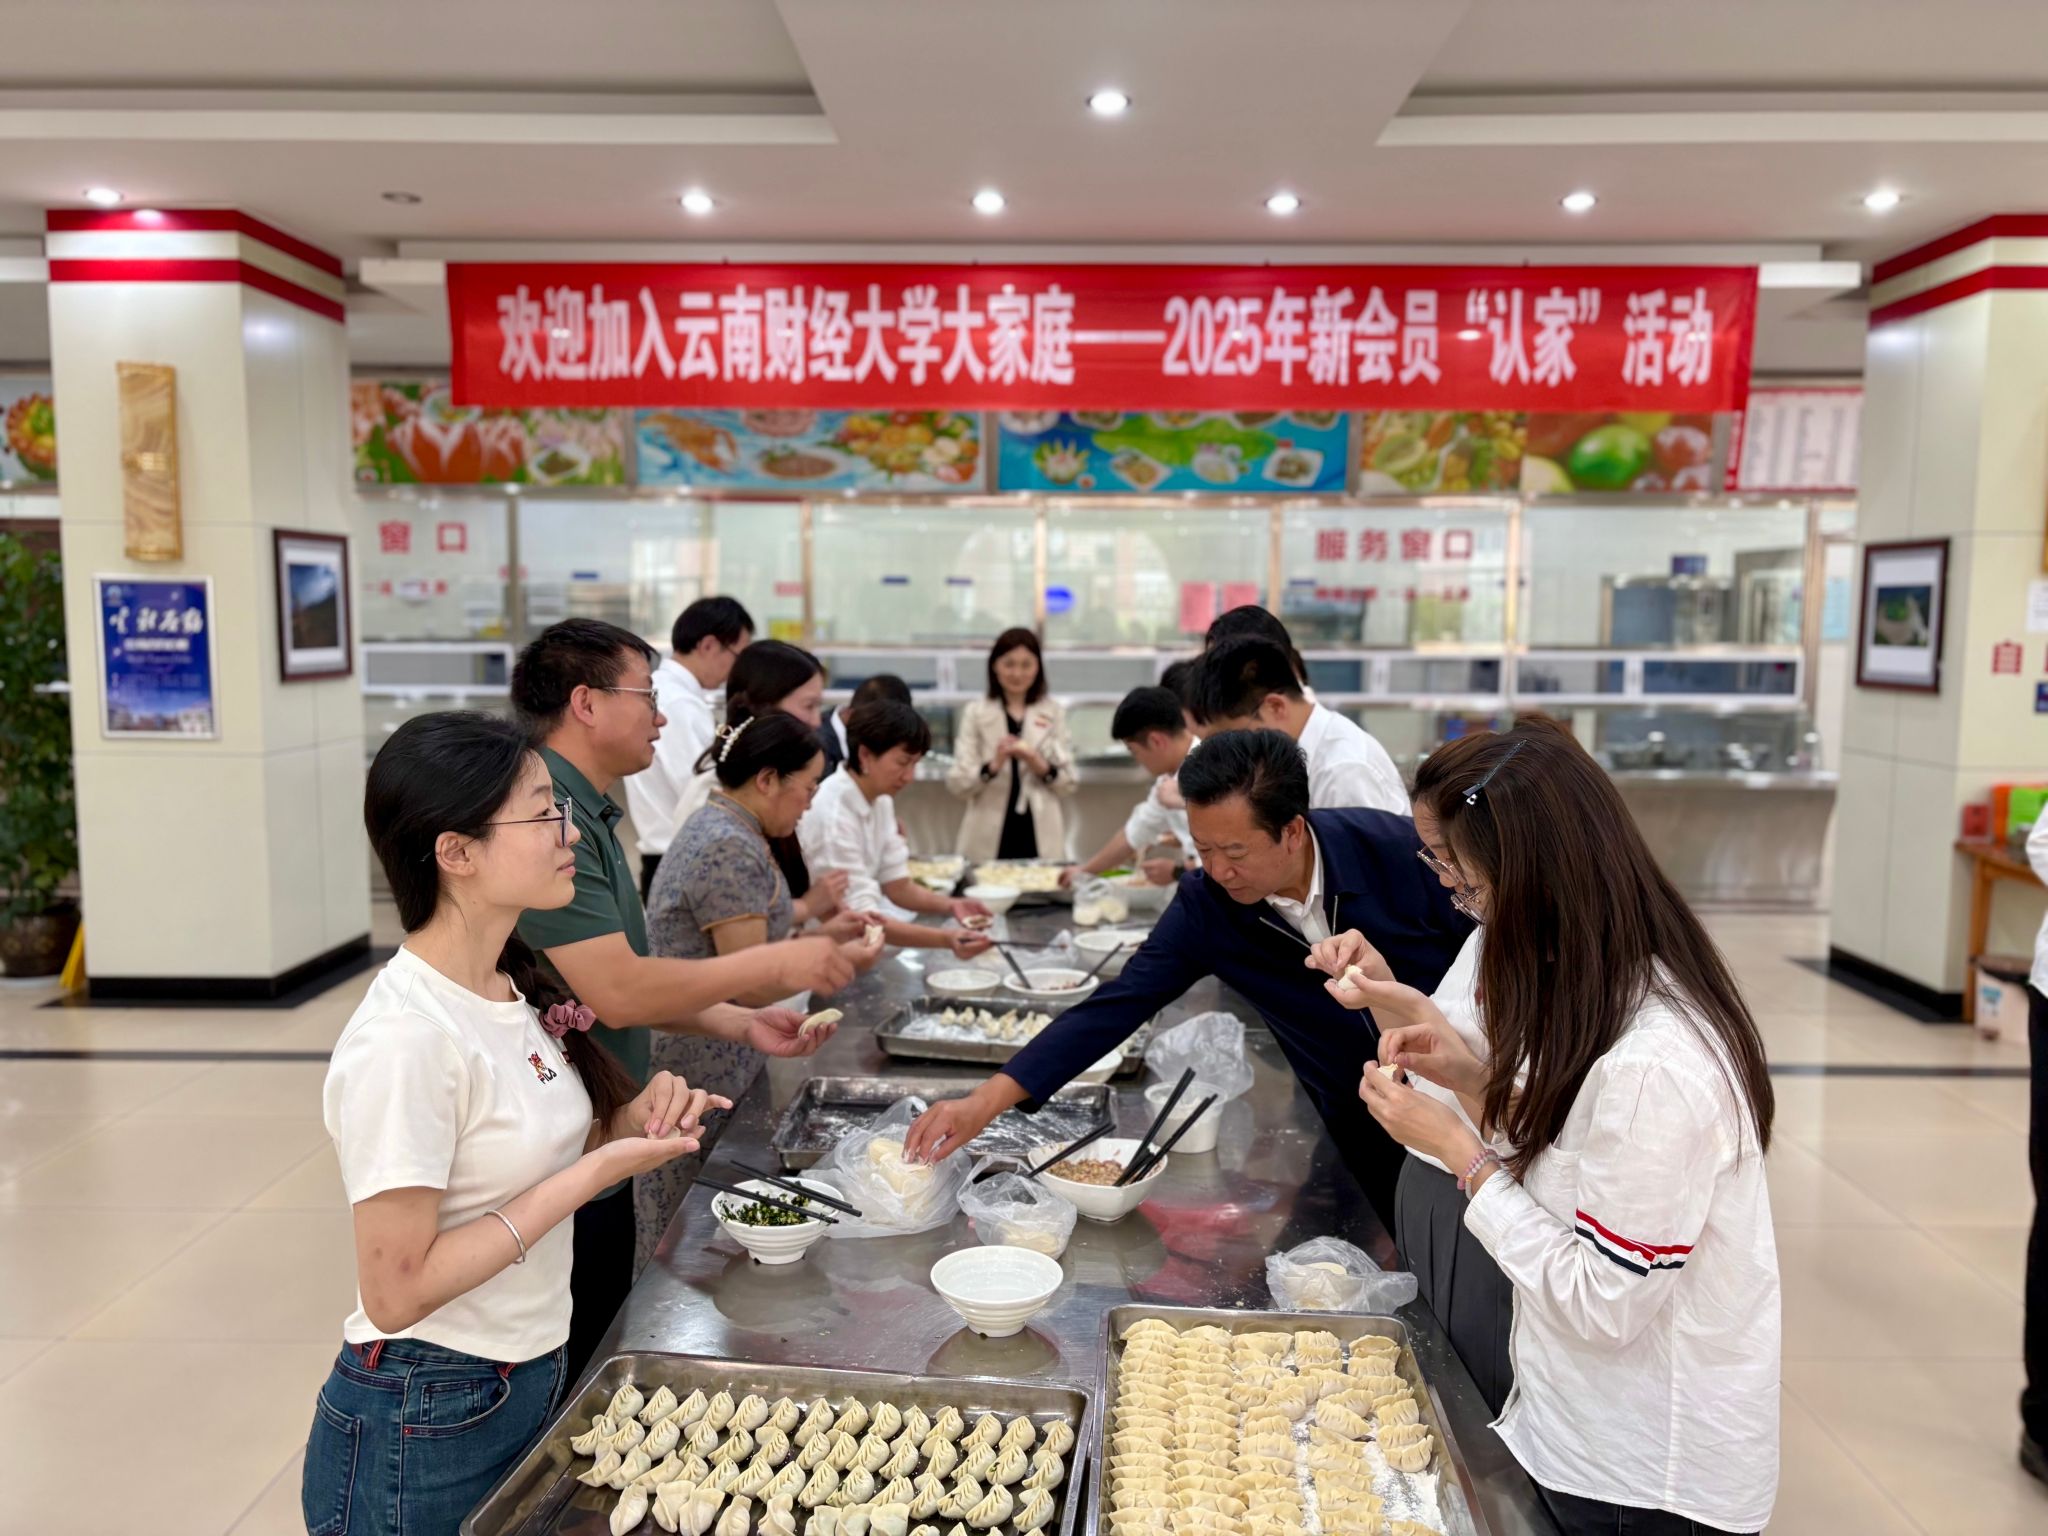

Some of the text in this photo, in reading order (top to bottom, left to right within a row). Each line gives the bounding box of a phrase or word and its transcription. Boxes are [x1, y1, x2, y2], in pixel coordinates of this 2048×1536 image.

[378, 519, 469, 555] 窗口
[1315, 528, 1473, 562] 服务窗口
